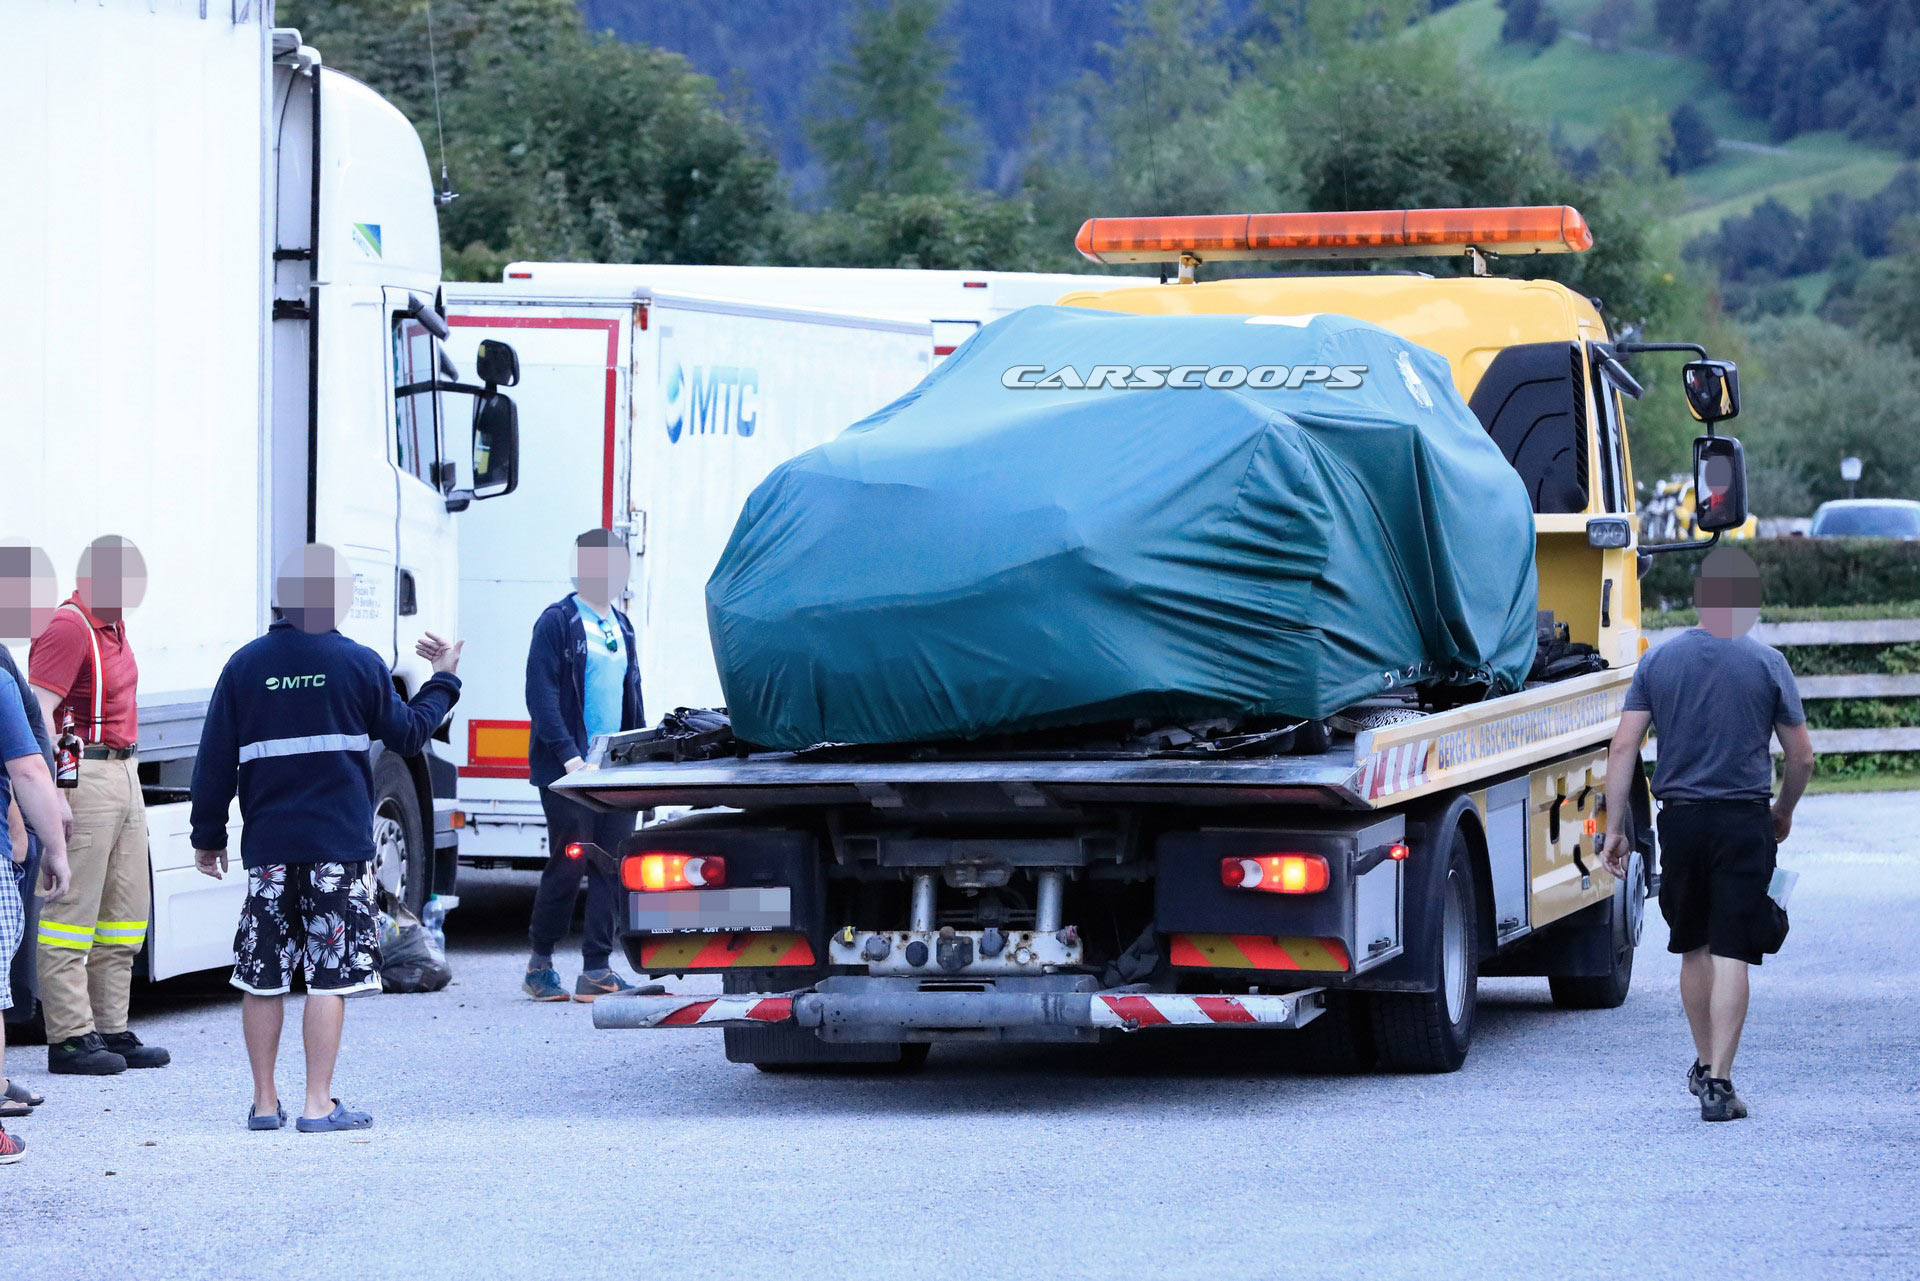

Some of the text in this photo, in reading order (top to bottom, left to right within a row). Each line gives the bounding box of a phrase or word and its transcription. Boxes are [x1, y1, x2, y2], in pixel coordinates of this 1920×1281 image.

[690, 365, 759, 438] MTC
[282, 674, 326, 689] MTC
[1438, 728, 1468, 770] BERGE
[1479, 706, 1551, 758] ABSCHLEPPDIENST
